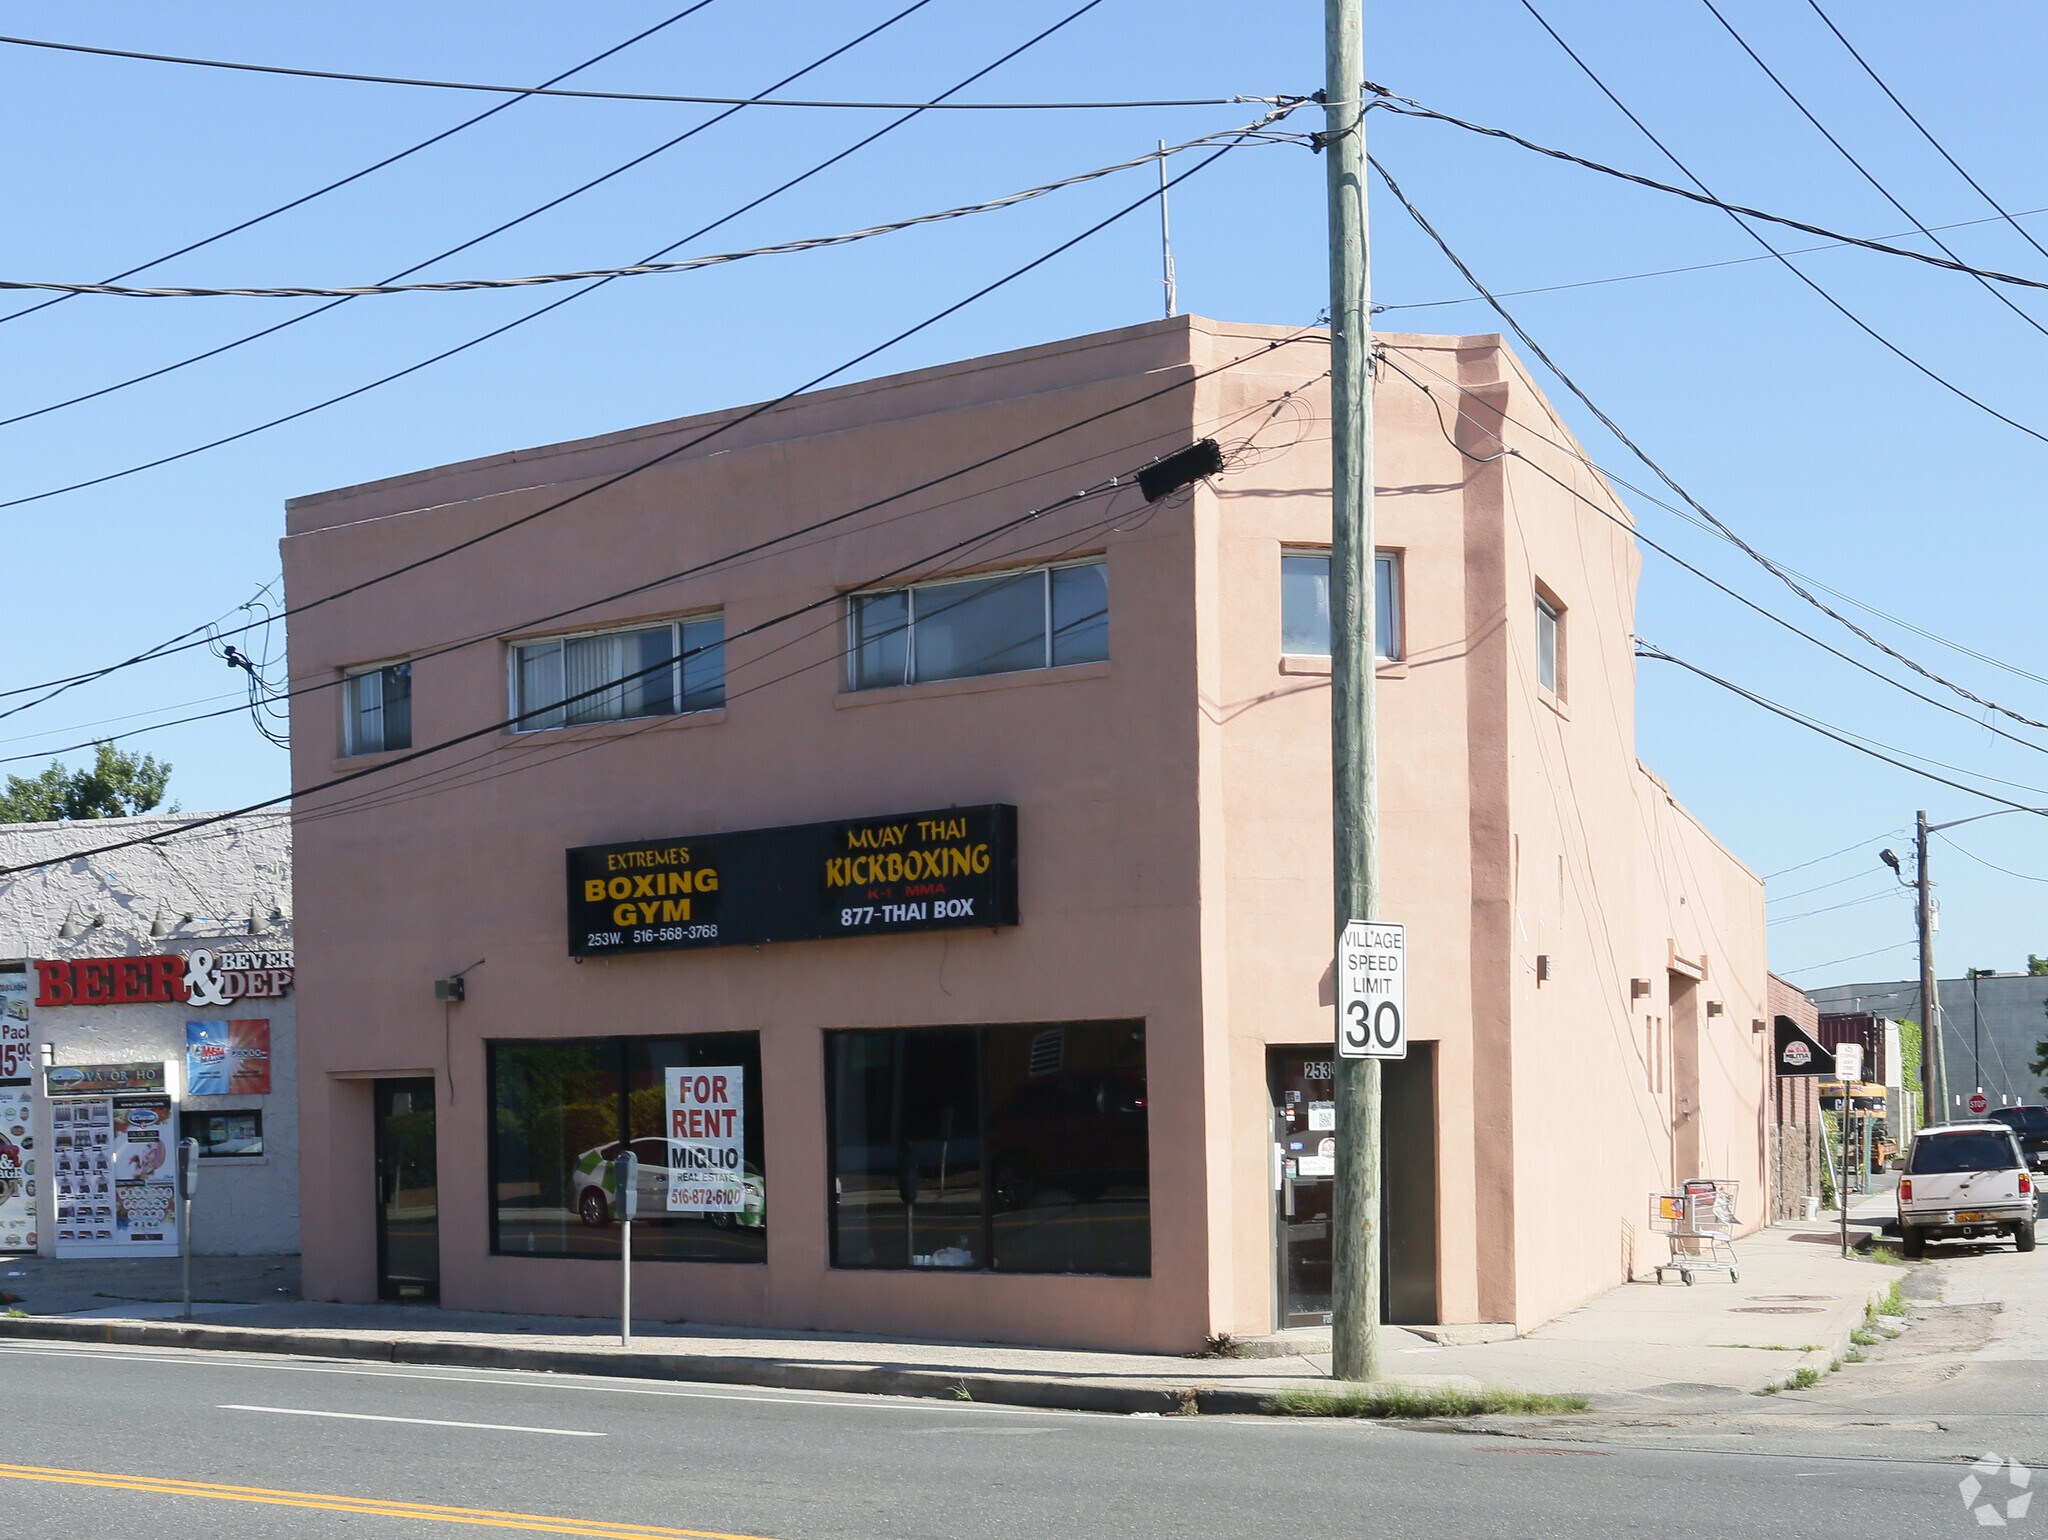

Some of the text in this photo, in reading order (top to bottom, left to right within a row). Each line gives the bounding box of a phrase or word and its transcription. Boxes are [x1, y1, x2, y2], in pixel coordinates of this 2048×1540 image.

[847, 817, 966, 850] MUAY THAI
[825, 843, 991, 889] KICKBOXING
[585, 868, 718, 902] BOXING
[867, 883, 946, 899] K-1 MMA
[613, 898, 690, 927] GYM
[840, 898, 974, 926] 877-THAI BOX
[588, 924, 718, 947] 253W. 516-568-3768
[1344, 931, 1402, 949] VILLAGE
[1348, 955, 1398, 971] SPEED
[34, 948, 234, 1007] BEER &
[221, 970, 293, 998] DEP
[1353, 977, 1392, 994] LIMIT
[1345, 1000, 1401, 1048] 30
[1306, 1062, 1330, 1078] 253
[680, 1075, 728, 1104] FOR
[1969, 1100, 1986, 1108] STOP
[672, 1109, 736, 1138] RENT
[672, 1147, 739, 1169] MIGLIO
[677, 1172, 735, 1183] REAL ESTATE
[672, 1188, 741, 1205] 516-872-6100
